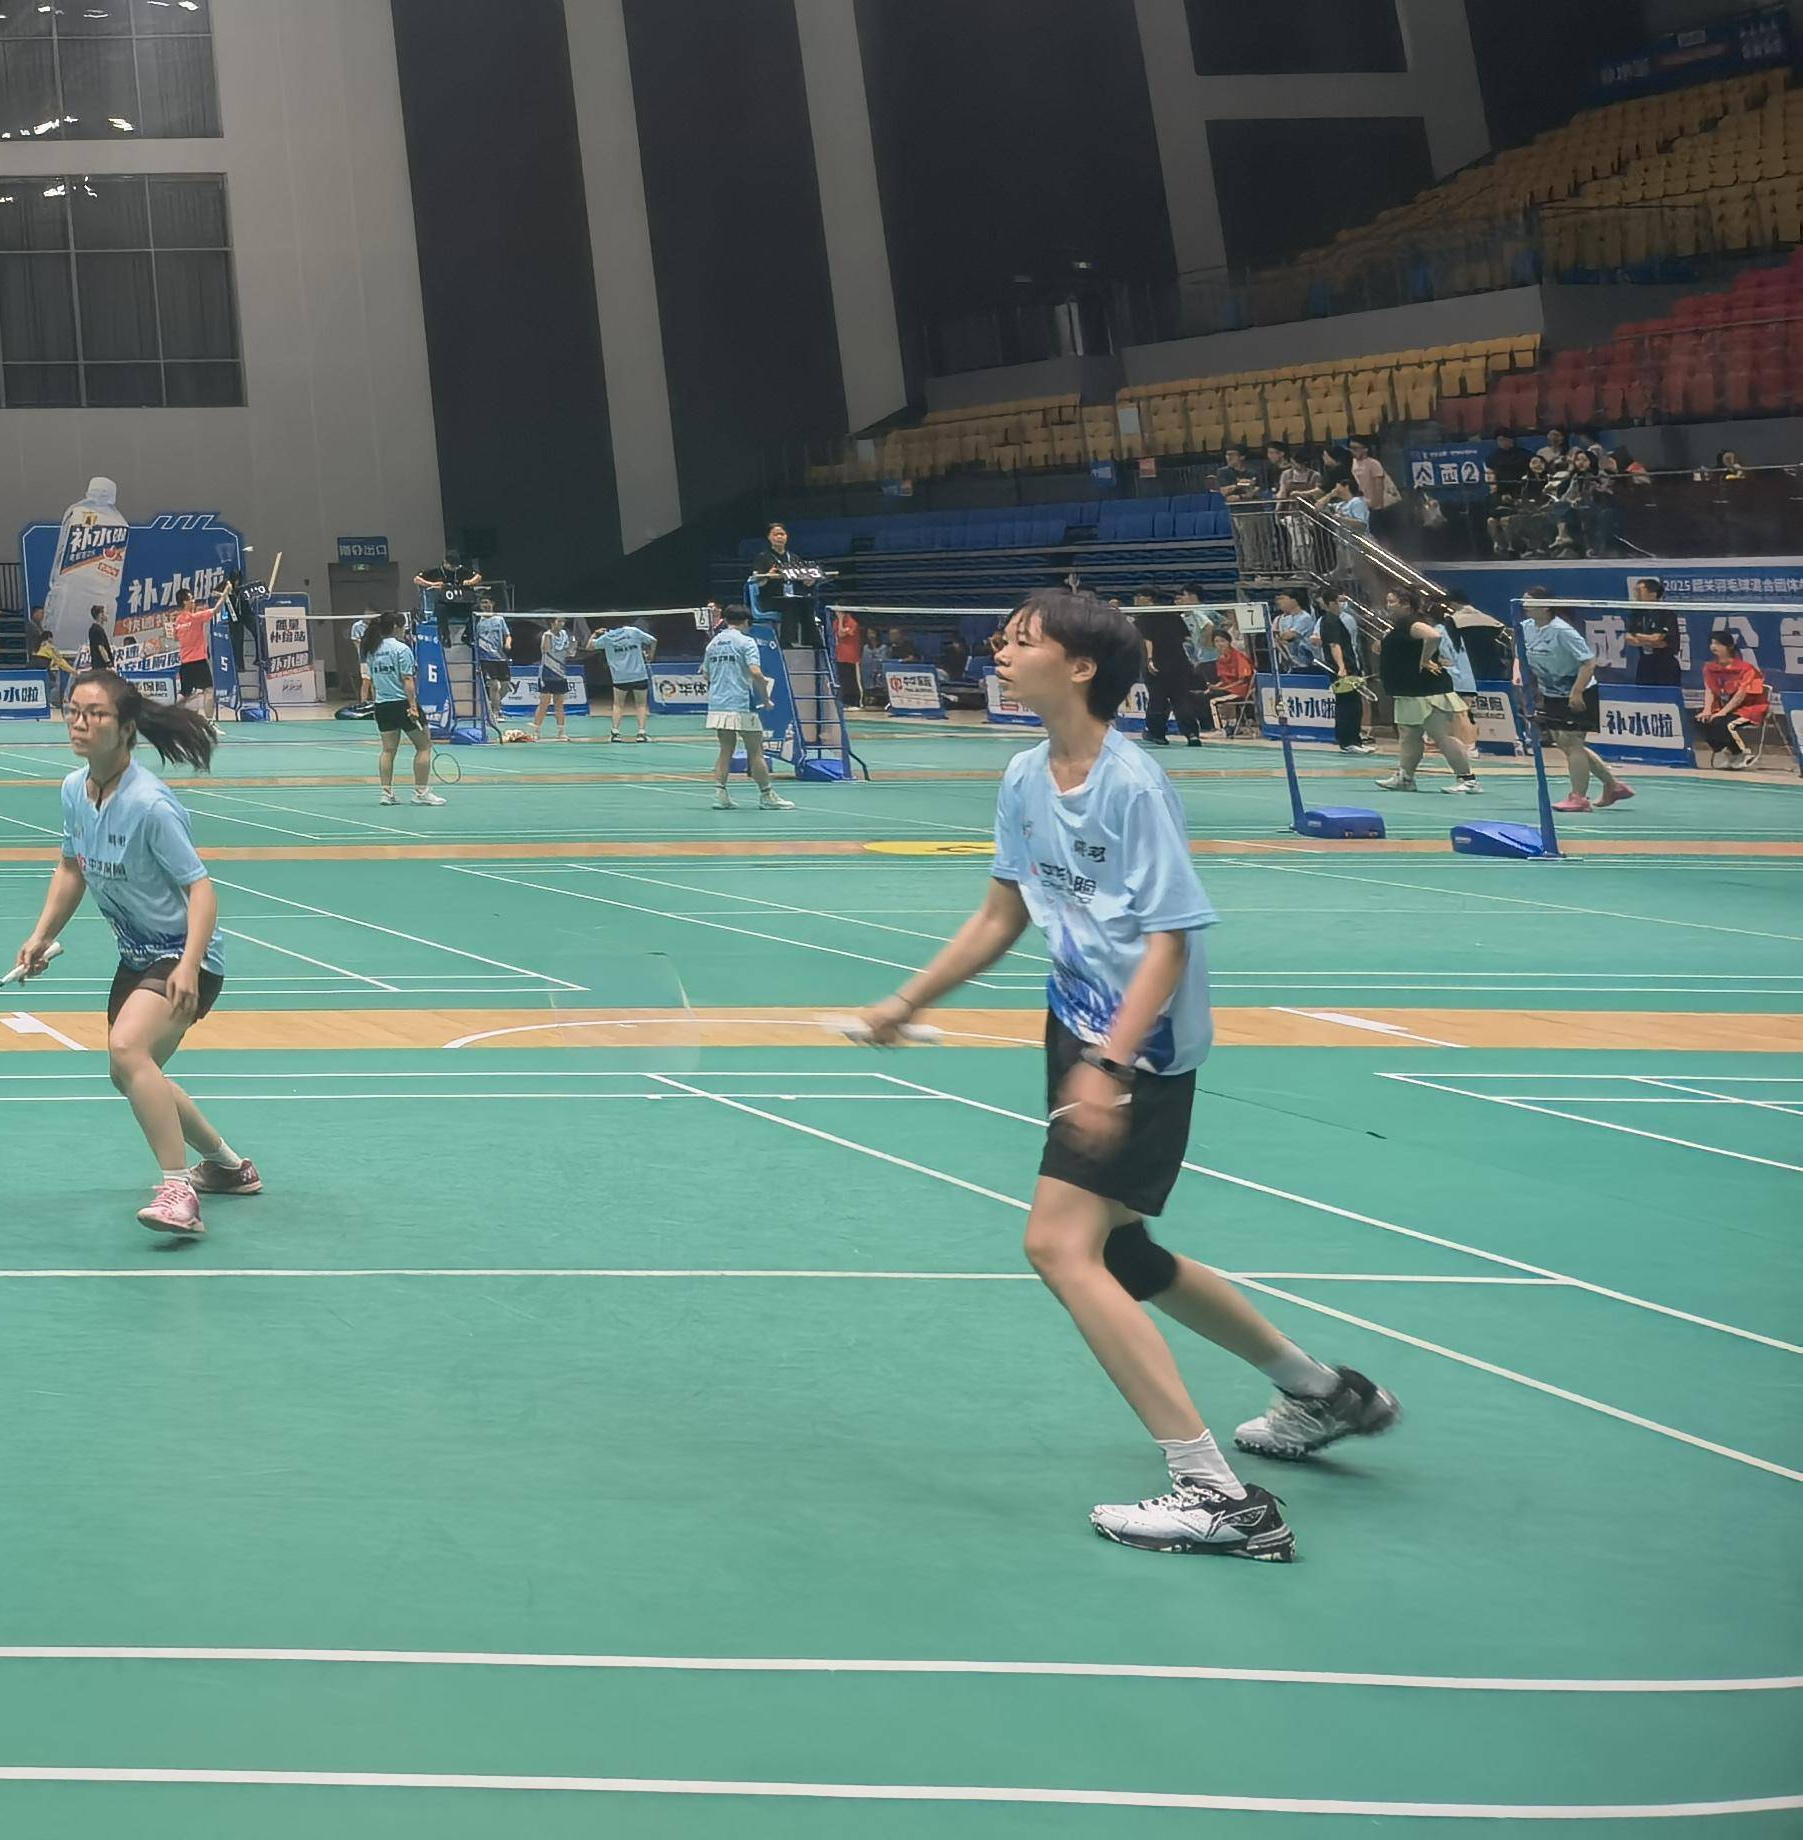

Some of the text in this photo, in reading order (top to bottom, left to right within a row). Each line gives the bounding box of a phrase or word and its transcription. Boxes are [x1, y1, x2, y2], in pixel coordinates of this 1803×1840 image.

[69, 527, 127, 554] 补水啦
[127, 566, 225, 614] 补水啦
[1248, 609, 1255, 626] 7
[220, 656, 228, 672] 5
[428, 664, 438, 683] 6
[1288, 696, 1337, 718] 补水啦
[1605, 710, 1674, 738] 补水啦
